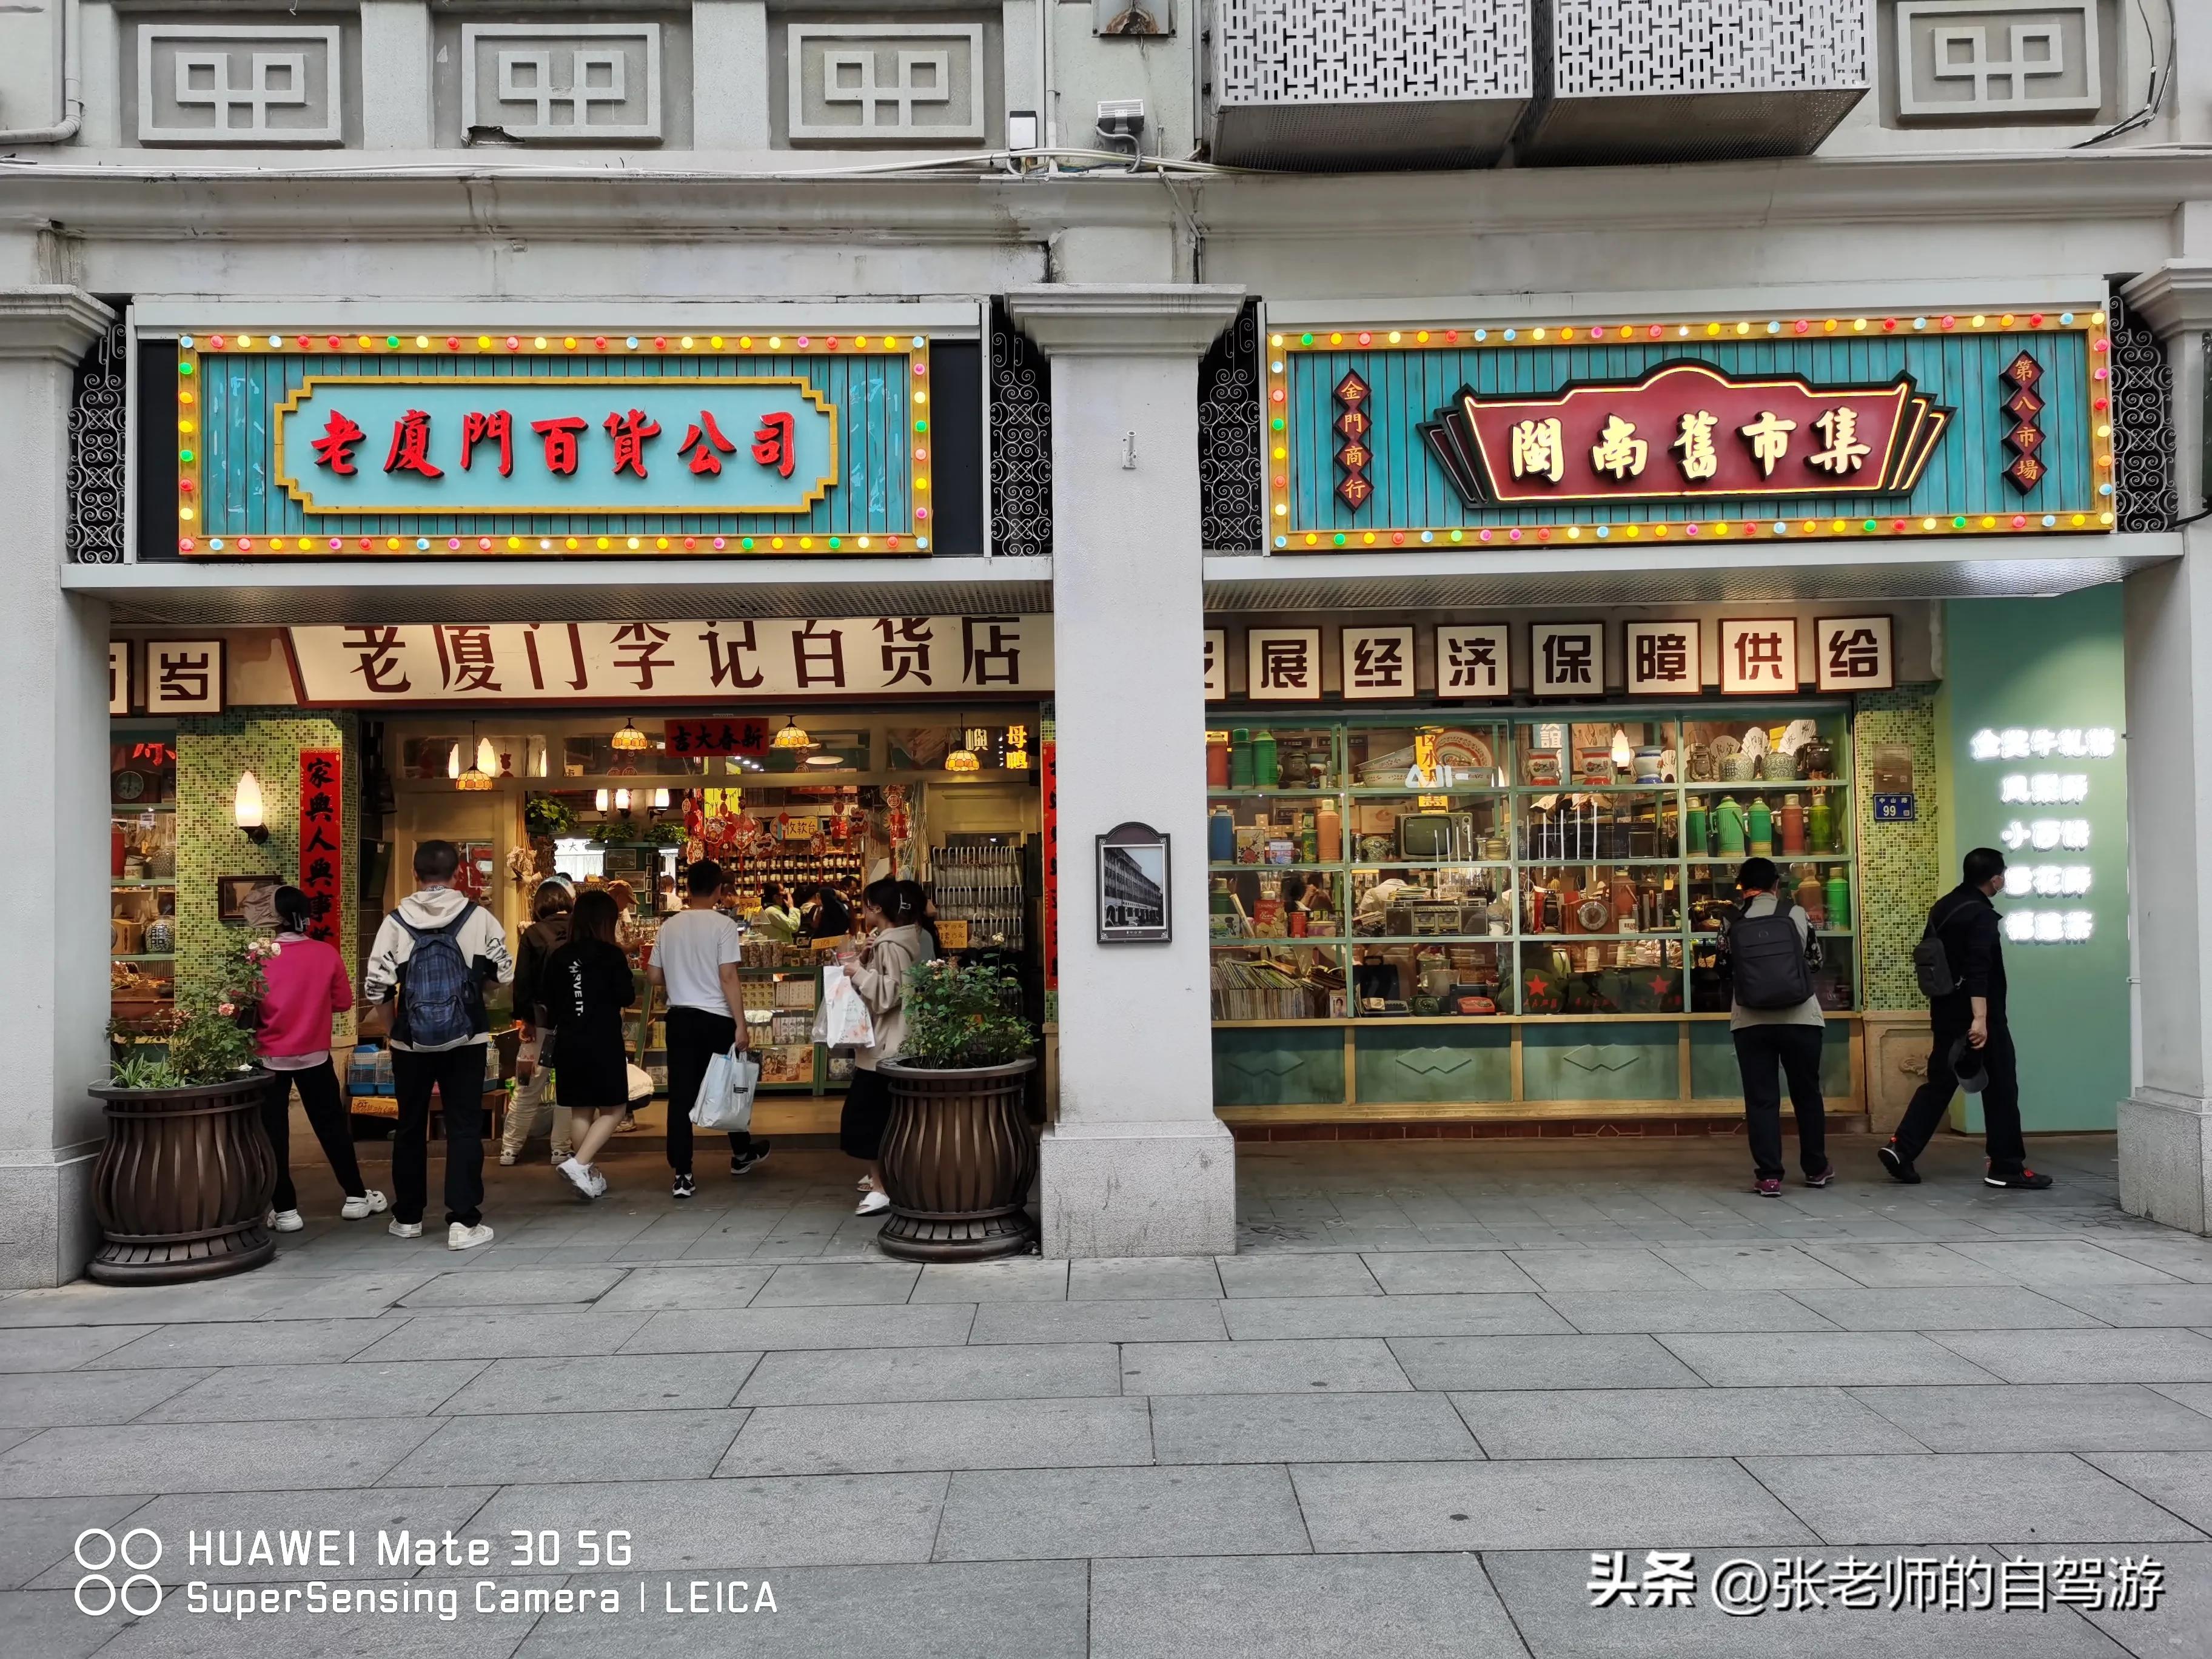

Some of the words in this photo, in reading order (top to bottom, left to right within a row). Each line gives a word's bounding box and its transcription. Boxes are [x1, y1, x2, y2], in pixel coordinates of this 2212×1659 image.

[310, 409, 796, 479] 老廈門百貨公司
[1341, 380, 1366, 499] 金門商行
[1511, 406, 1872, 483] 閩南舊市集
[2014, 360, 2039, 480] 第八市場
[344, 617, 1021, 694] 老厦门李记百货店
[1204, 628, 1880, 689] 展经济保障供给
[1883, 805, 1896, 817] 99
